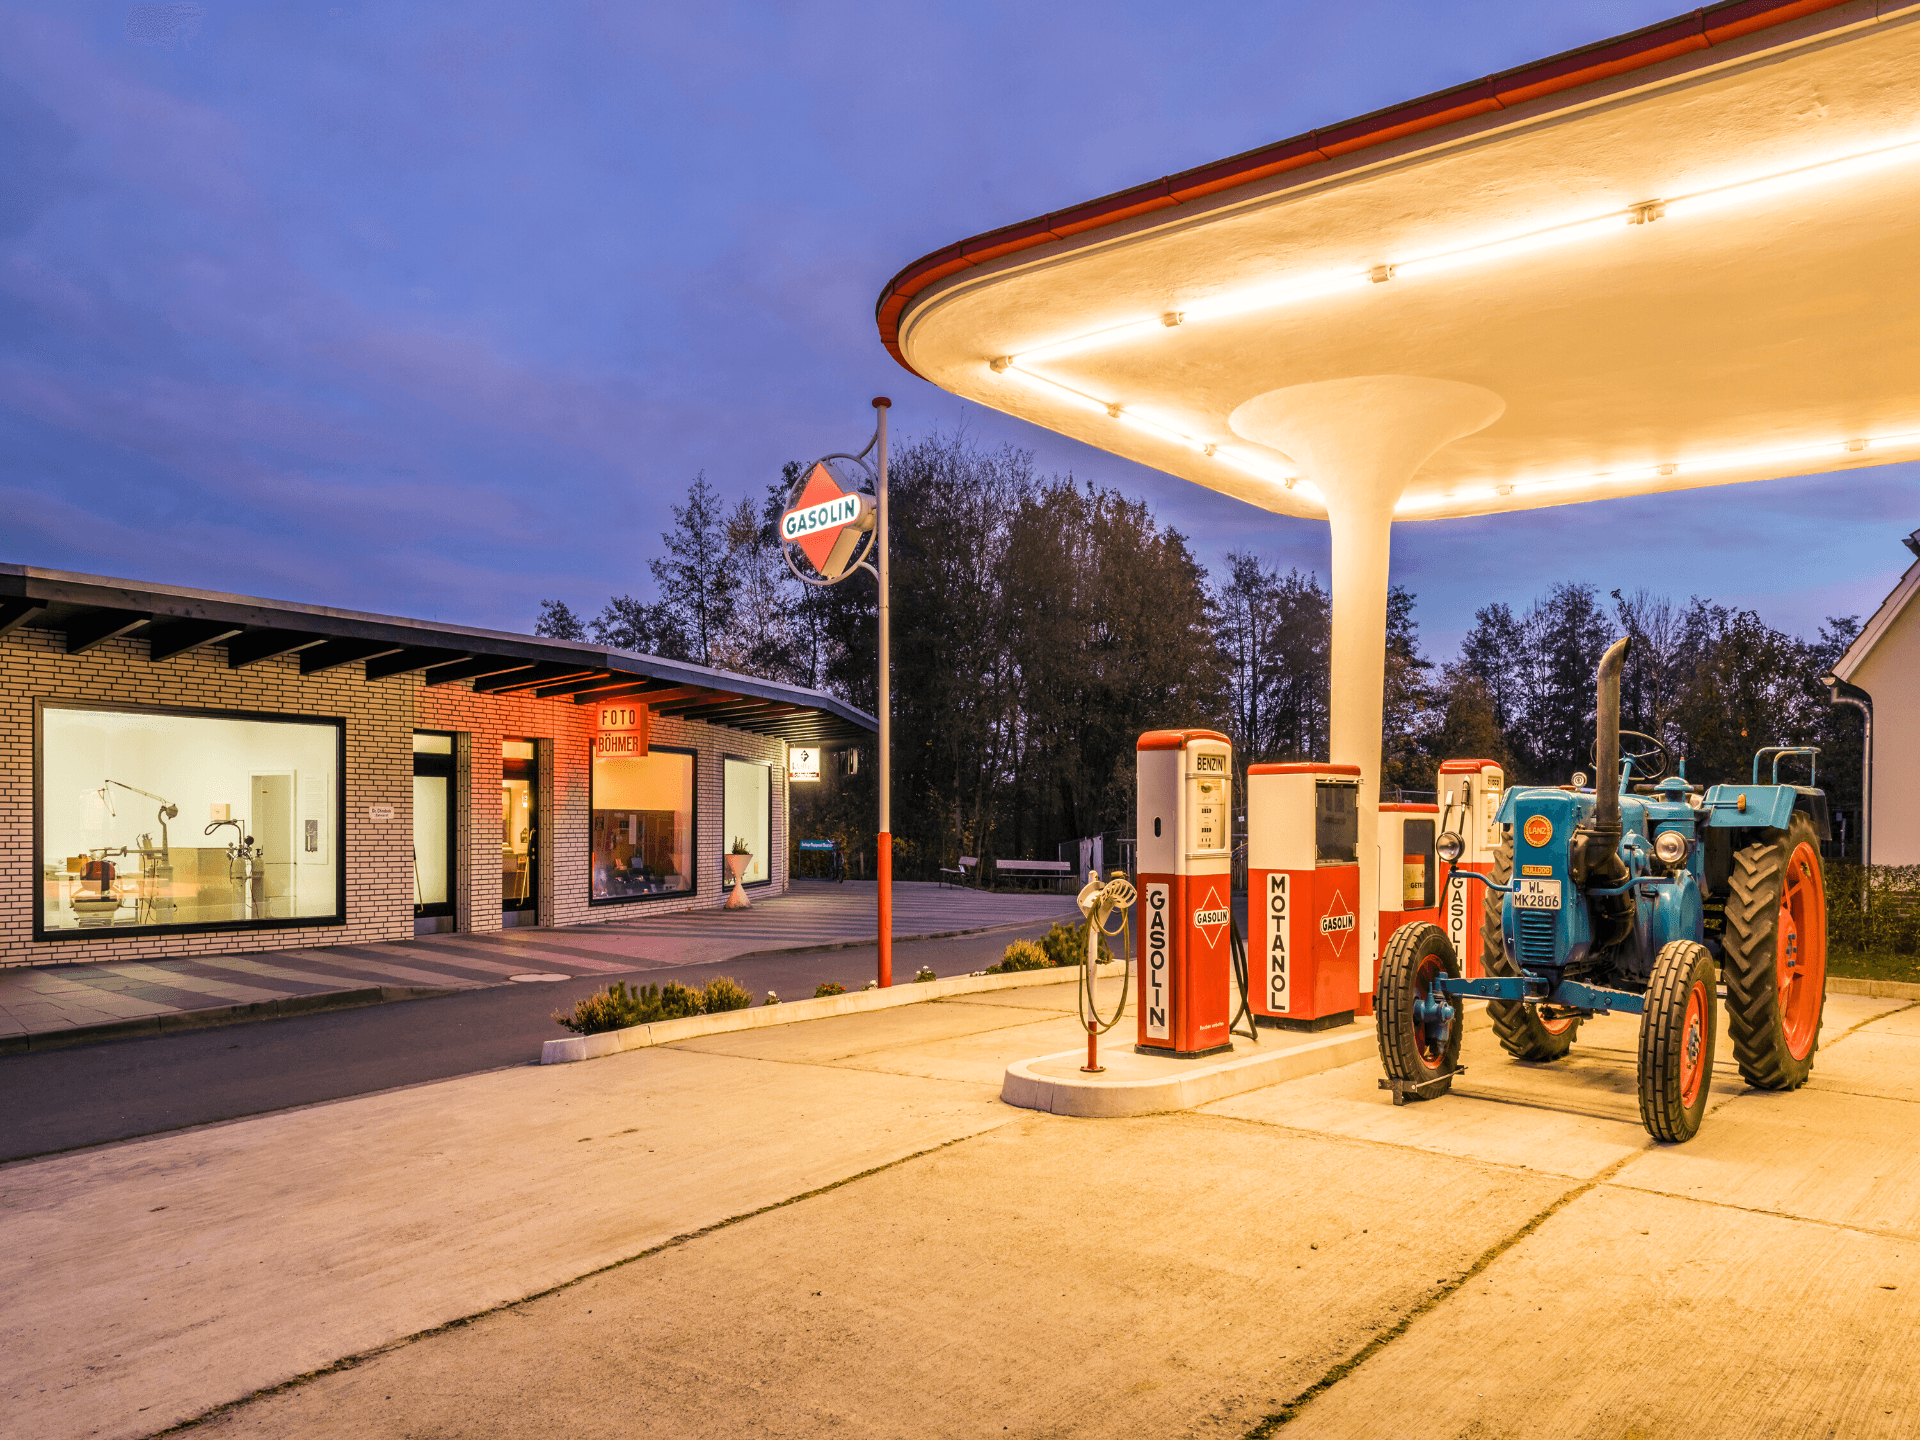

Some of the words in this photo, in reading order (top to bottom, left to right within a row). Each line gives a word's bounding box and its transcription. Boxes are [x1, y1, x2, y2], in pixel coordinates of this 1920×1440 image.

[786, 499, 855, 535] GASOLIN
[602, 709, 636, 725] FOTO
[598, 733, 639, 752] BÖHMER
[1197, 757, 1223, 771] BENZIN
[1529, 827, 1547, 835] LANZ
[1523, 866, 1550, 874] BULLDOG
[1529, 882, 1543, 893] WL
[1514, 895, 1559, 907] MK2806
[1196, 910, 1228, 924] GASOLIN
[1322, 915, 1353, 931] GASOLIN
[1271, 876, 1286, 1010] MOTANOL
[1149, 890, 1166, 1027] GASOLIN
